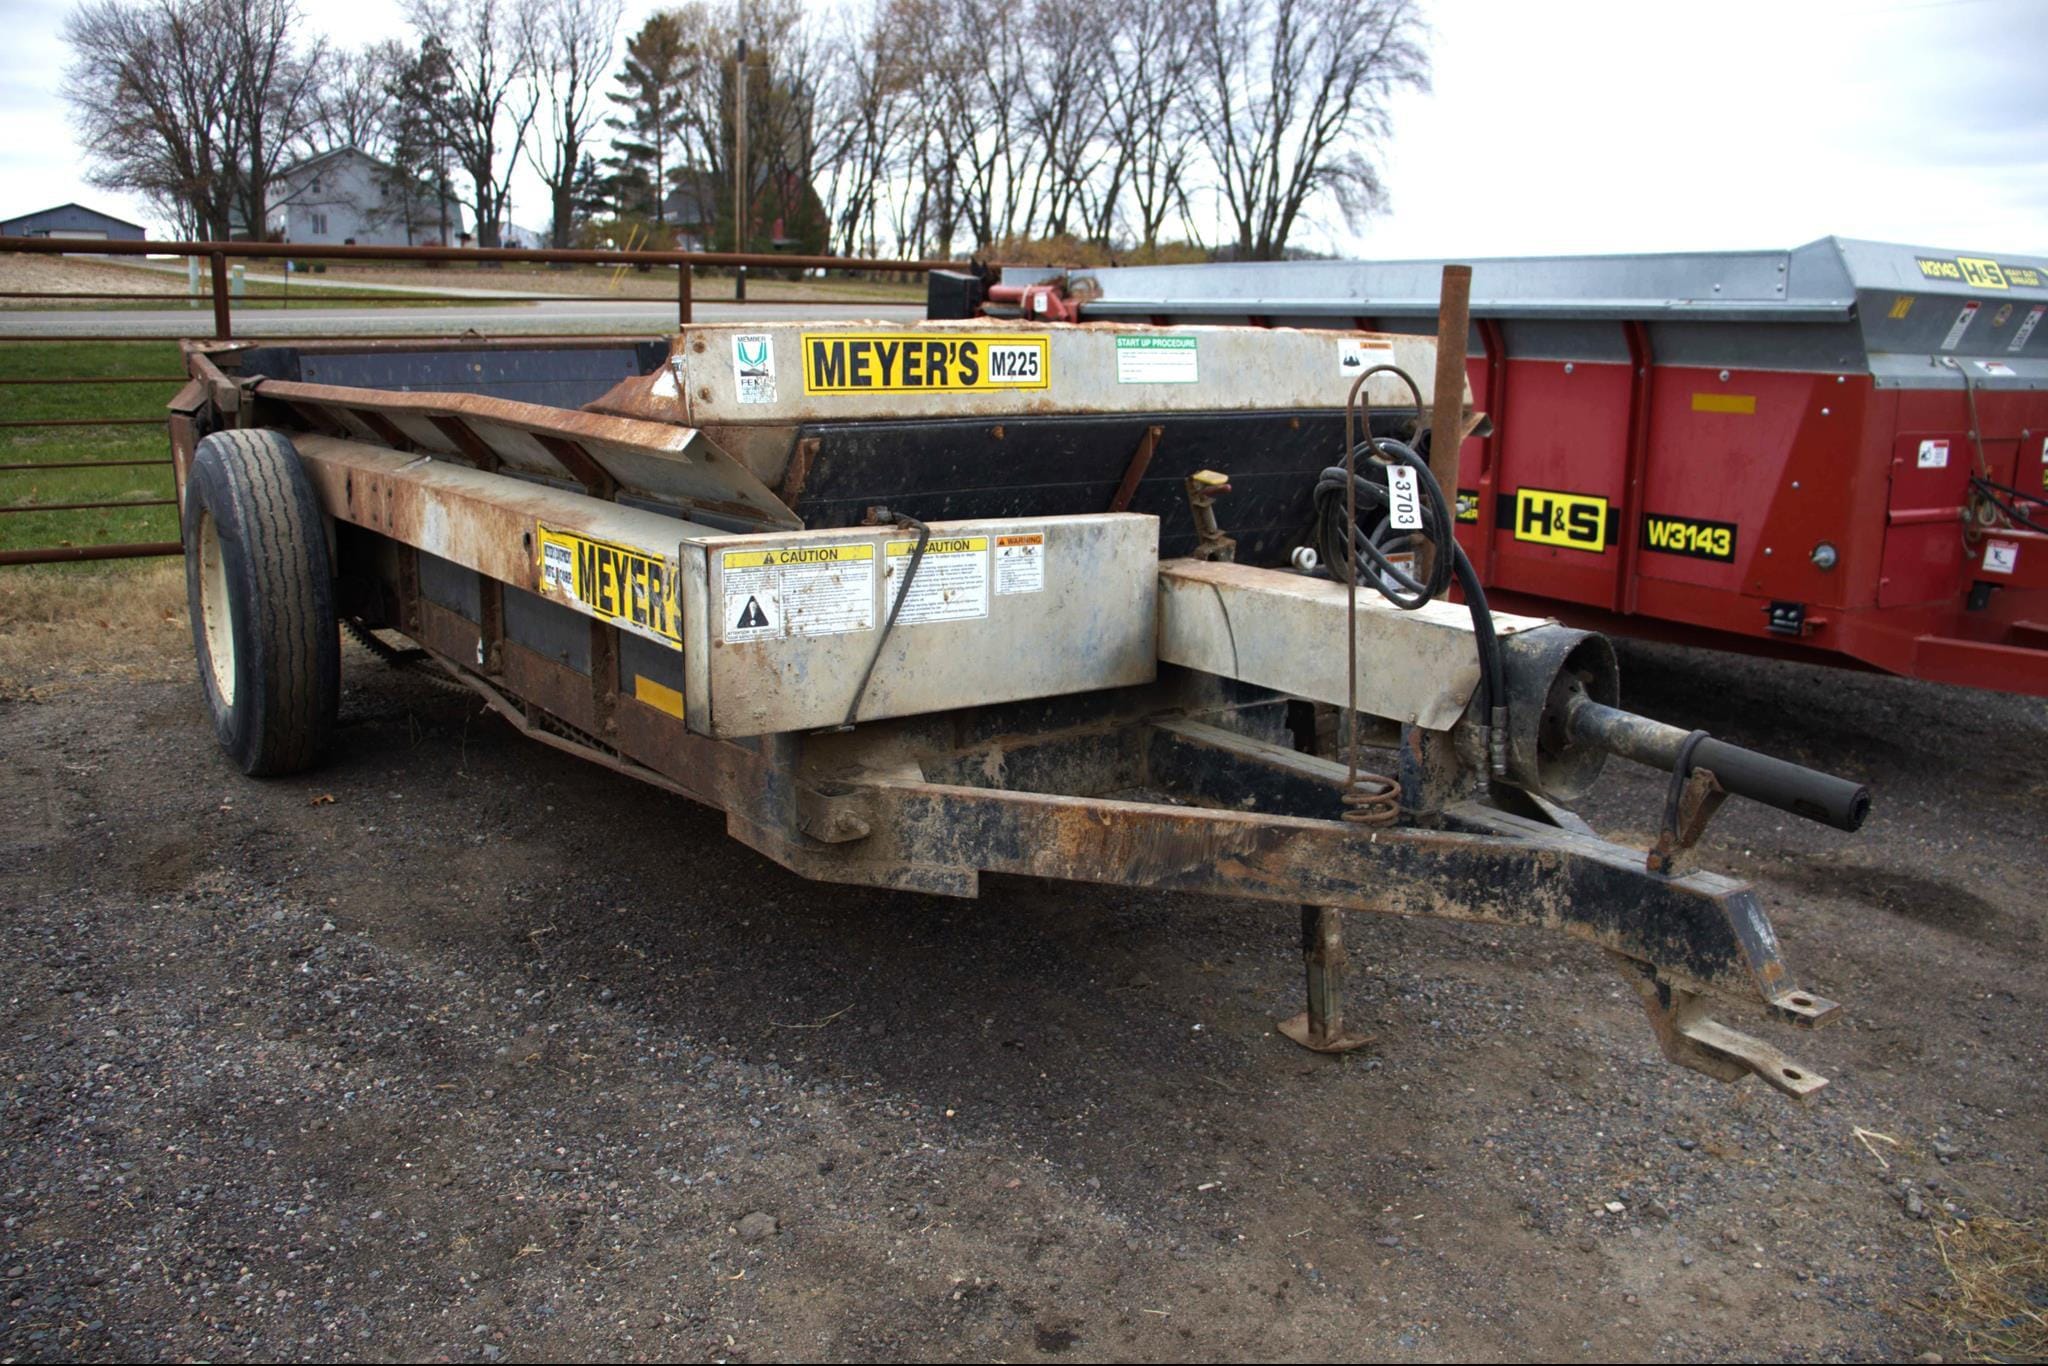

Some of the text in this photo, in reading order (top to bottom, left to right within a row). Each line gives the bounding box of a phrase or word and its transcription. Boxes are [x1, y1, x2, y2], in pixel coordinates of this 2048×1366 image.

[1117, 338, 1196, 348] START UP PROCEDURE
[813, 340, 979, 388] MEYER'S
[991, 351, 1039, 378] M225
[1395, 480, 1415, 525] 3703
[1521, 496, 1599, 543] H&S
[1007, 535, 1041, 545] WARNING
[1648, 519, 1731, 556] W3143
[780, 549, 838, 564] CAUTION
